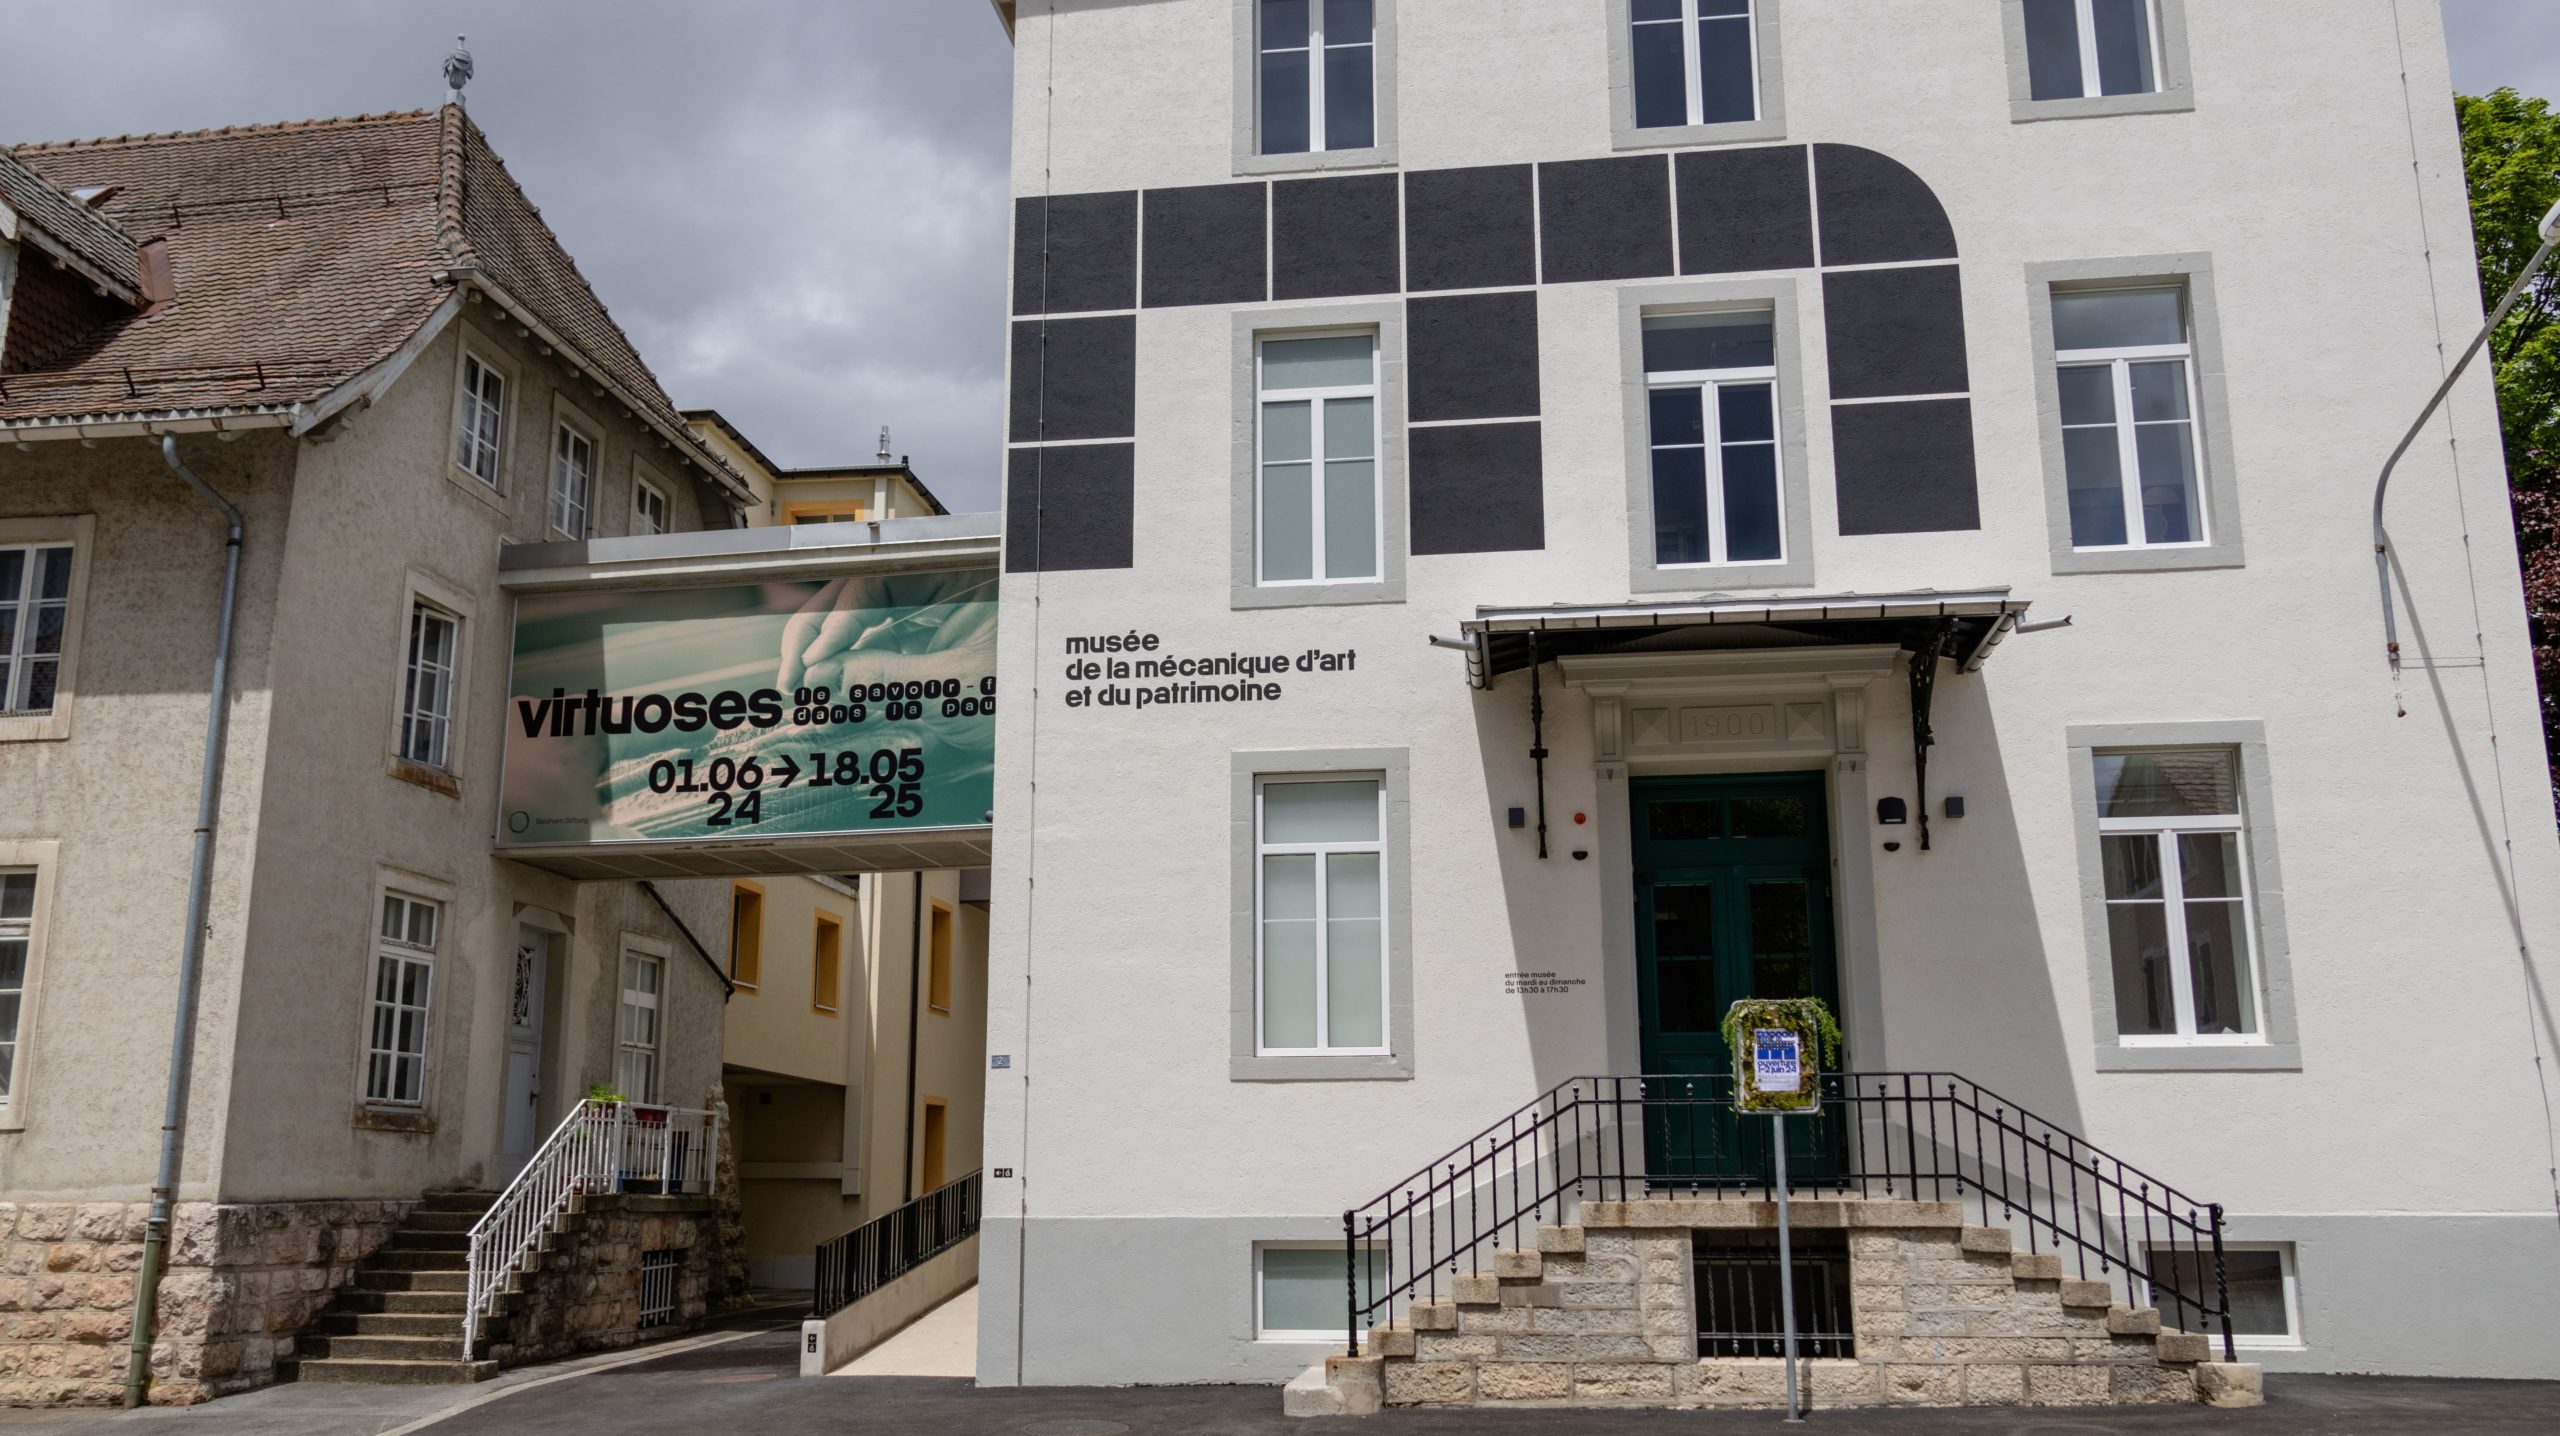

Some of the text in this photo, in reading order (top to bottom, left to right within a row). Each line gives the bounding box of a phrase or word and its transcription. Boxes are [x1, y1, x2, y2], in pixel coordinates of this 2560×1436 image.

[1065, 630, 1160, 654] musée
[1065, 649, 1356, 680] de la mécanique d'art
[796, 687, 829, 704] le
[1065, 679, 1282, 709] et du patrimoine
[518, 687, 783, 739] virtuoses
[795, 706, 865, 724] dans
[888, 703, 920, 718] la
[1691, 711, 1764, 737] 1900
[648, 747, 925, 794] 01.06 18.05
[706, 783, 923, 826] 24 25
[1772, 1066, 1785, 1074] juin
